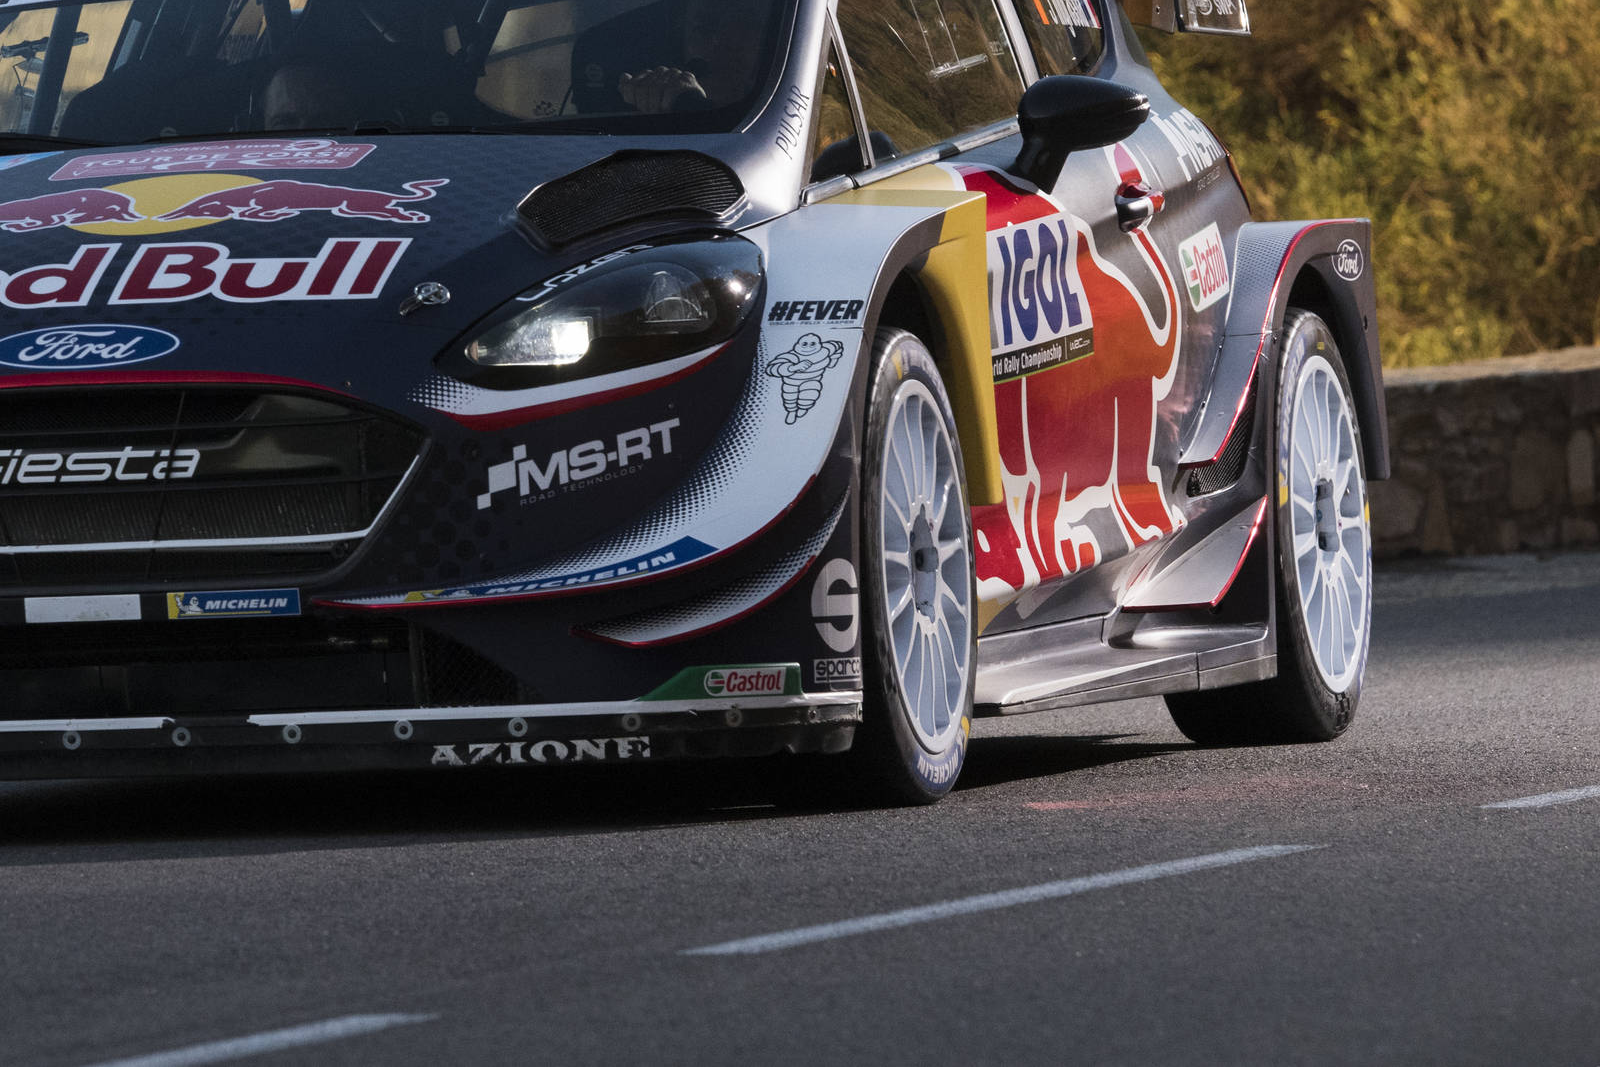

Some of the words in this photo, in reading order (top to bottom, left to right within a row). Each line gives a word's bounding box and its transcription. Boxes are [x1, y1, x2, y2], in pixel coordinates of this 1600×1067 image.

[775, 85, 810, 160] PULSAR
[81, 156, 170, 168] TOUR
[185, 153, 230, 161] DE
[242, 151, 353, 159] CORSE
[107, 238, 412, 305] Bull
[1193, 233, 1229, 299] Castrol
[1336, 245, 1359, 275] Ford
[996, 219, 1083, 346] IGOL
[768, 300, 864, 321] #FEVER
[17, 329, 137, 361] Ford
[1003, 354, 1021, 378] Rally
[1021, 344, 1063, 370] Championship
[519, 490, 557, 506] ROAD
[563, 464, 644, 493] TECHNOLOGY
[485, 552, 676, 595] MICHELIN
[204, 597, 288, 611] MICHELIN
[726, 670, 781, 693] Castrol
